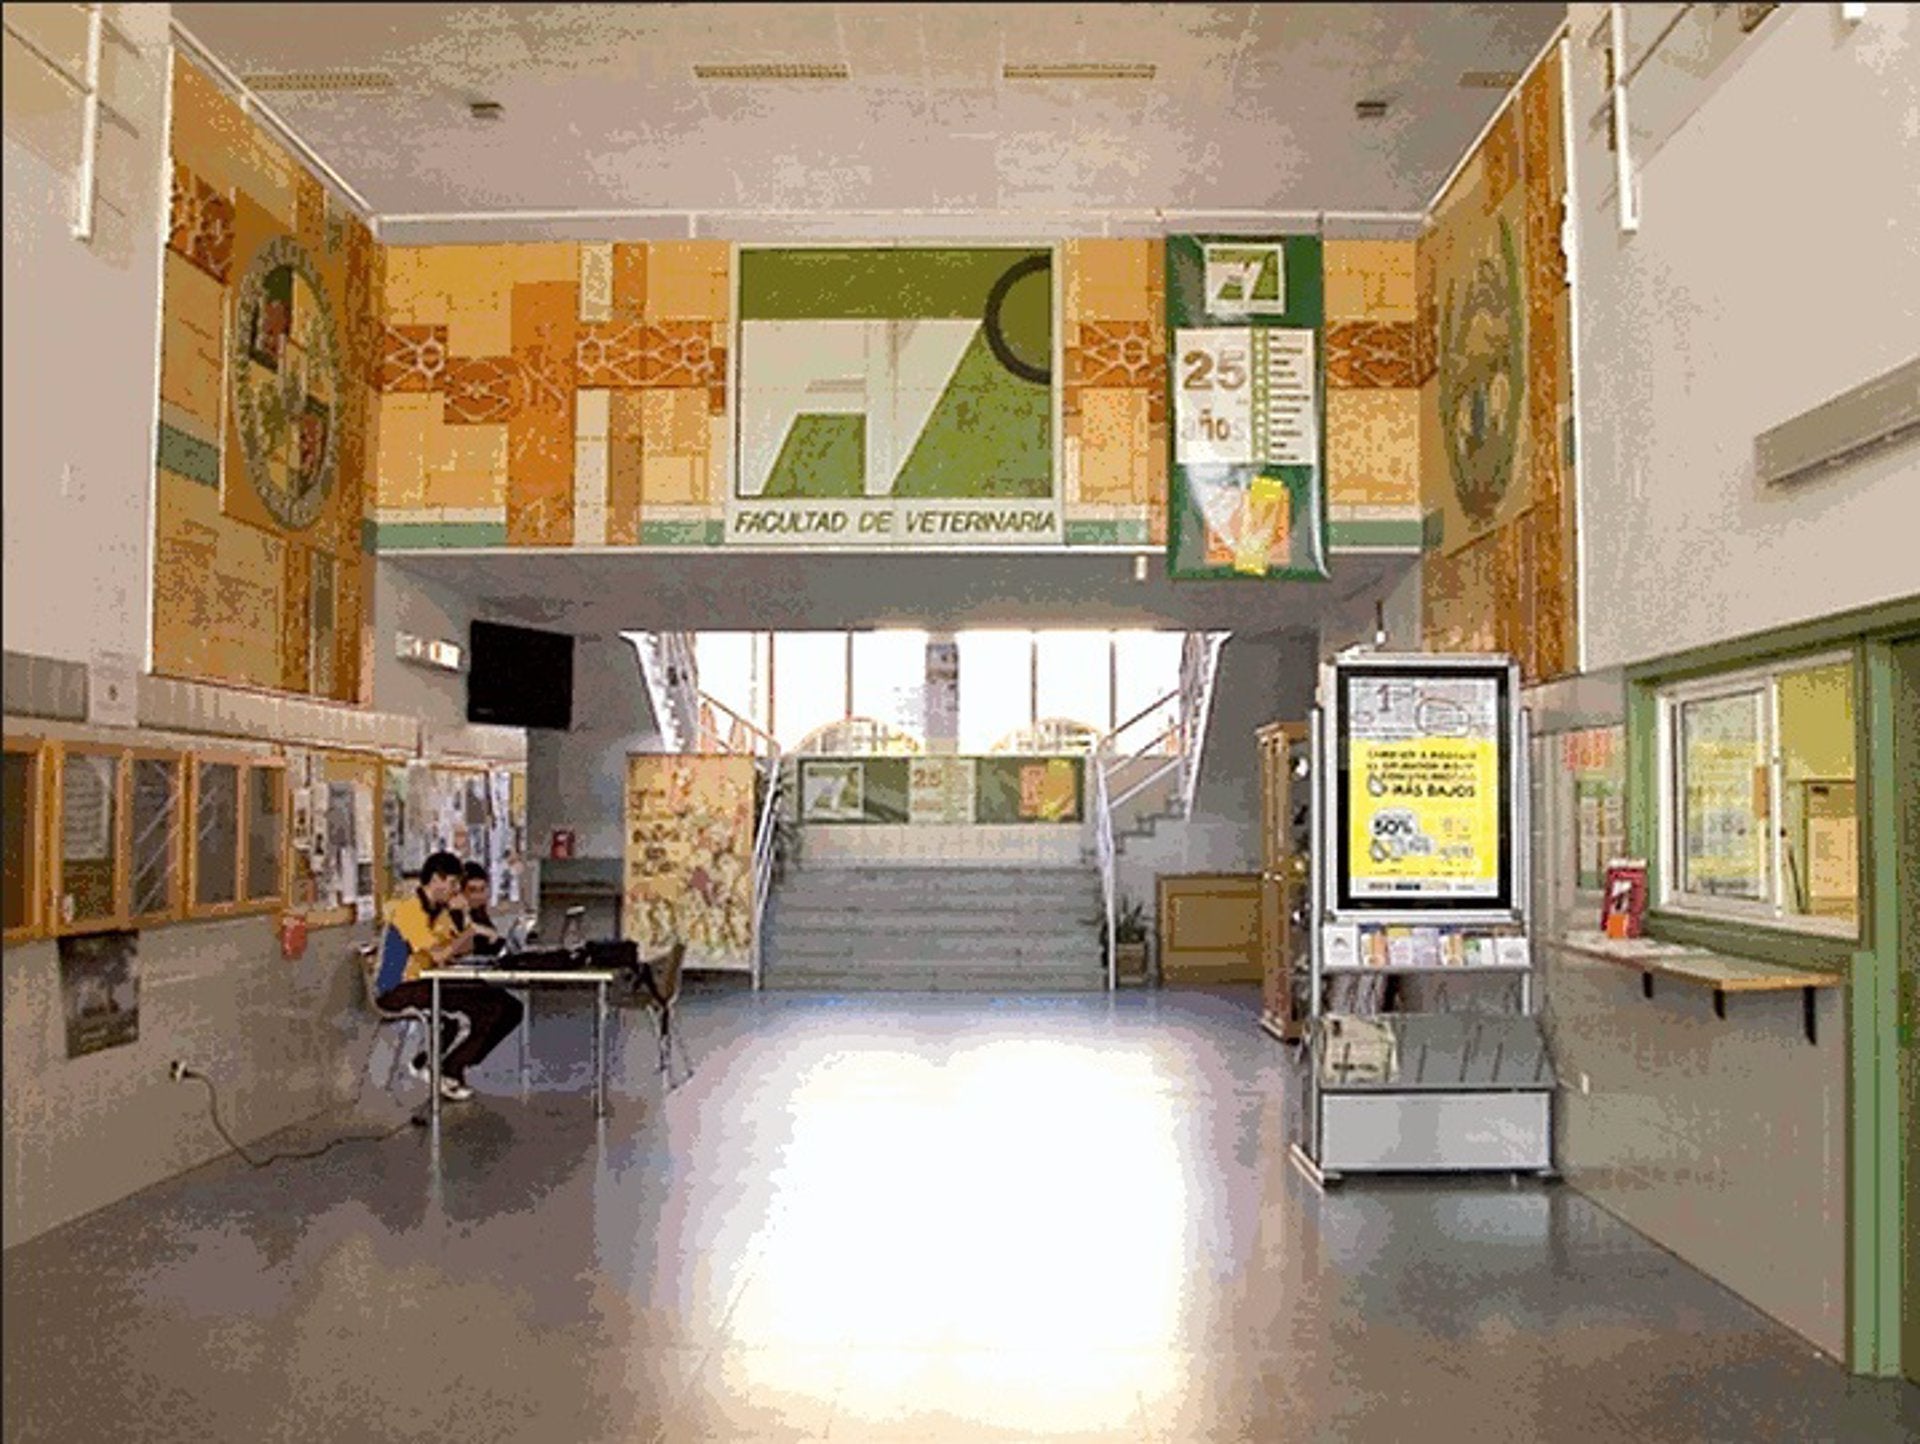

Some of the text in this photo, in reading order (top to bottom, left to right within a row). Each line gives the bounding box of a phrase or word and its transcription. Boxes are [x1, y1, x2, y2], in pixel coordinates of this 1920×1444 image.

[1183, 349, 1247, 391] 25
[734, 510, 1057, 534] FACULTAD DE VETERINARIA
[1393, 780, 1476, 797] MÁS BAJOS
[1373, 818, 1413, 835] 50%
